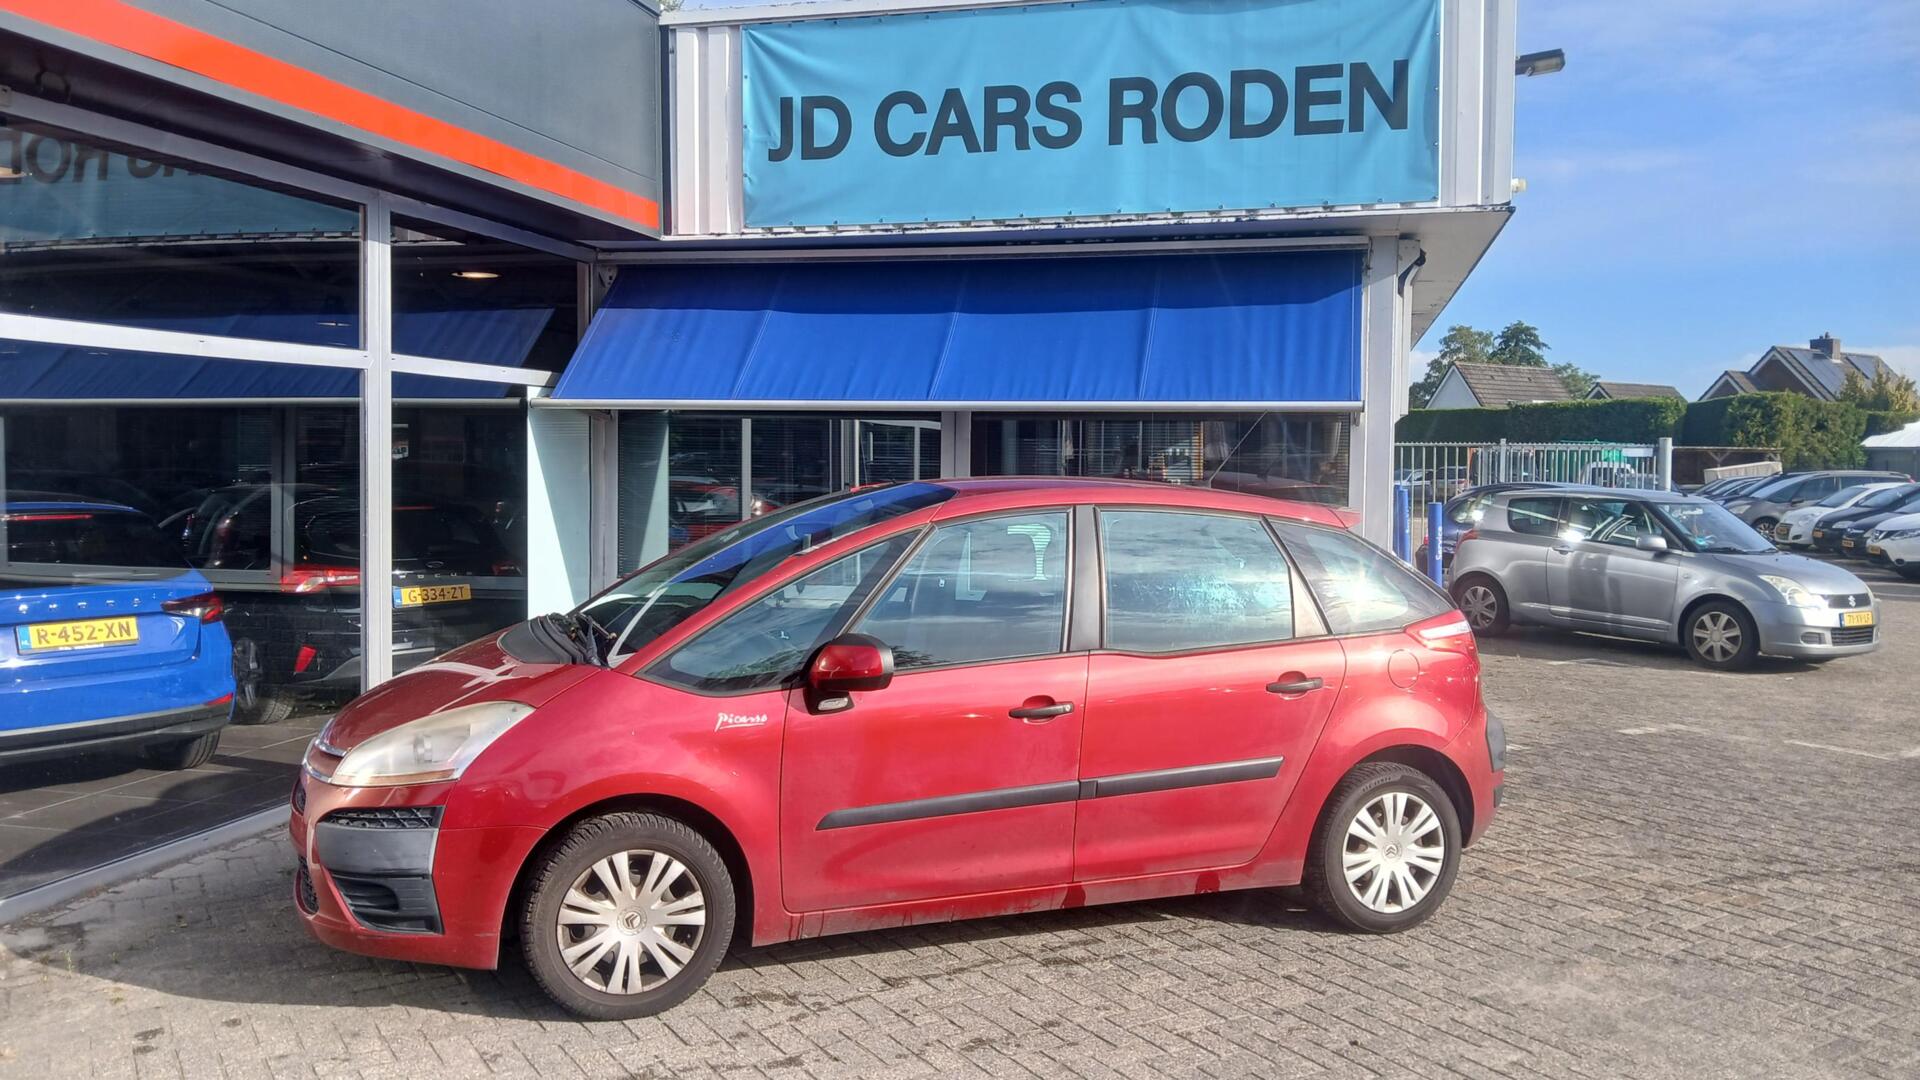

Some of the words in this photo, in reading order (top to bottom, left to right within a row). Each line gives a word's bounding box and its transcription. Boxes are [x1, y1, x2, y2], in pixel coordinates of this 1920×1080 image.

[767, 95, 853, 163] JD
[873, 81, 1083, 158] CARS
[1108, 58, 1410, 146] RODEN
[399, 571, 472, 579] OCU
[408, 585, 466, 603] G-334-ZT
[36, 620, 132, 645] R-452-XN
